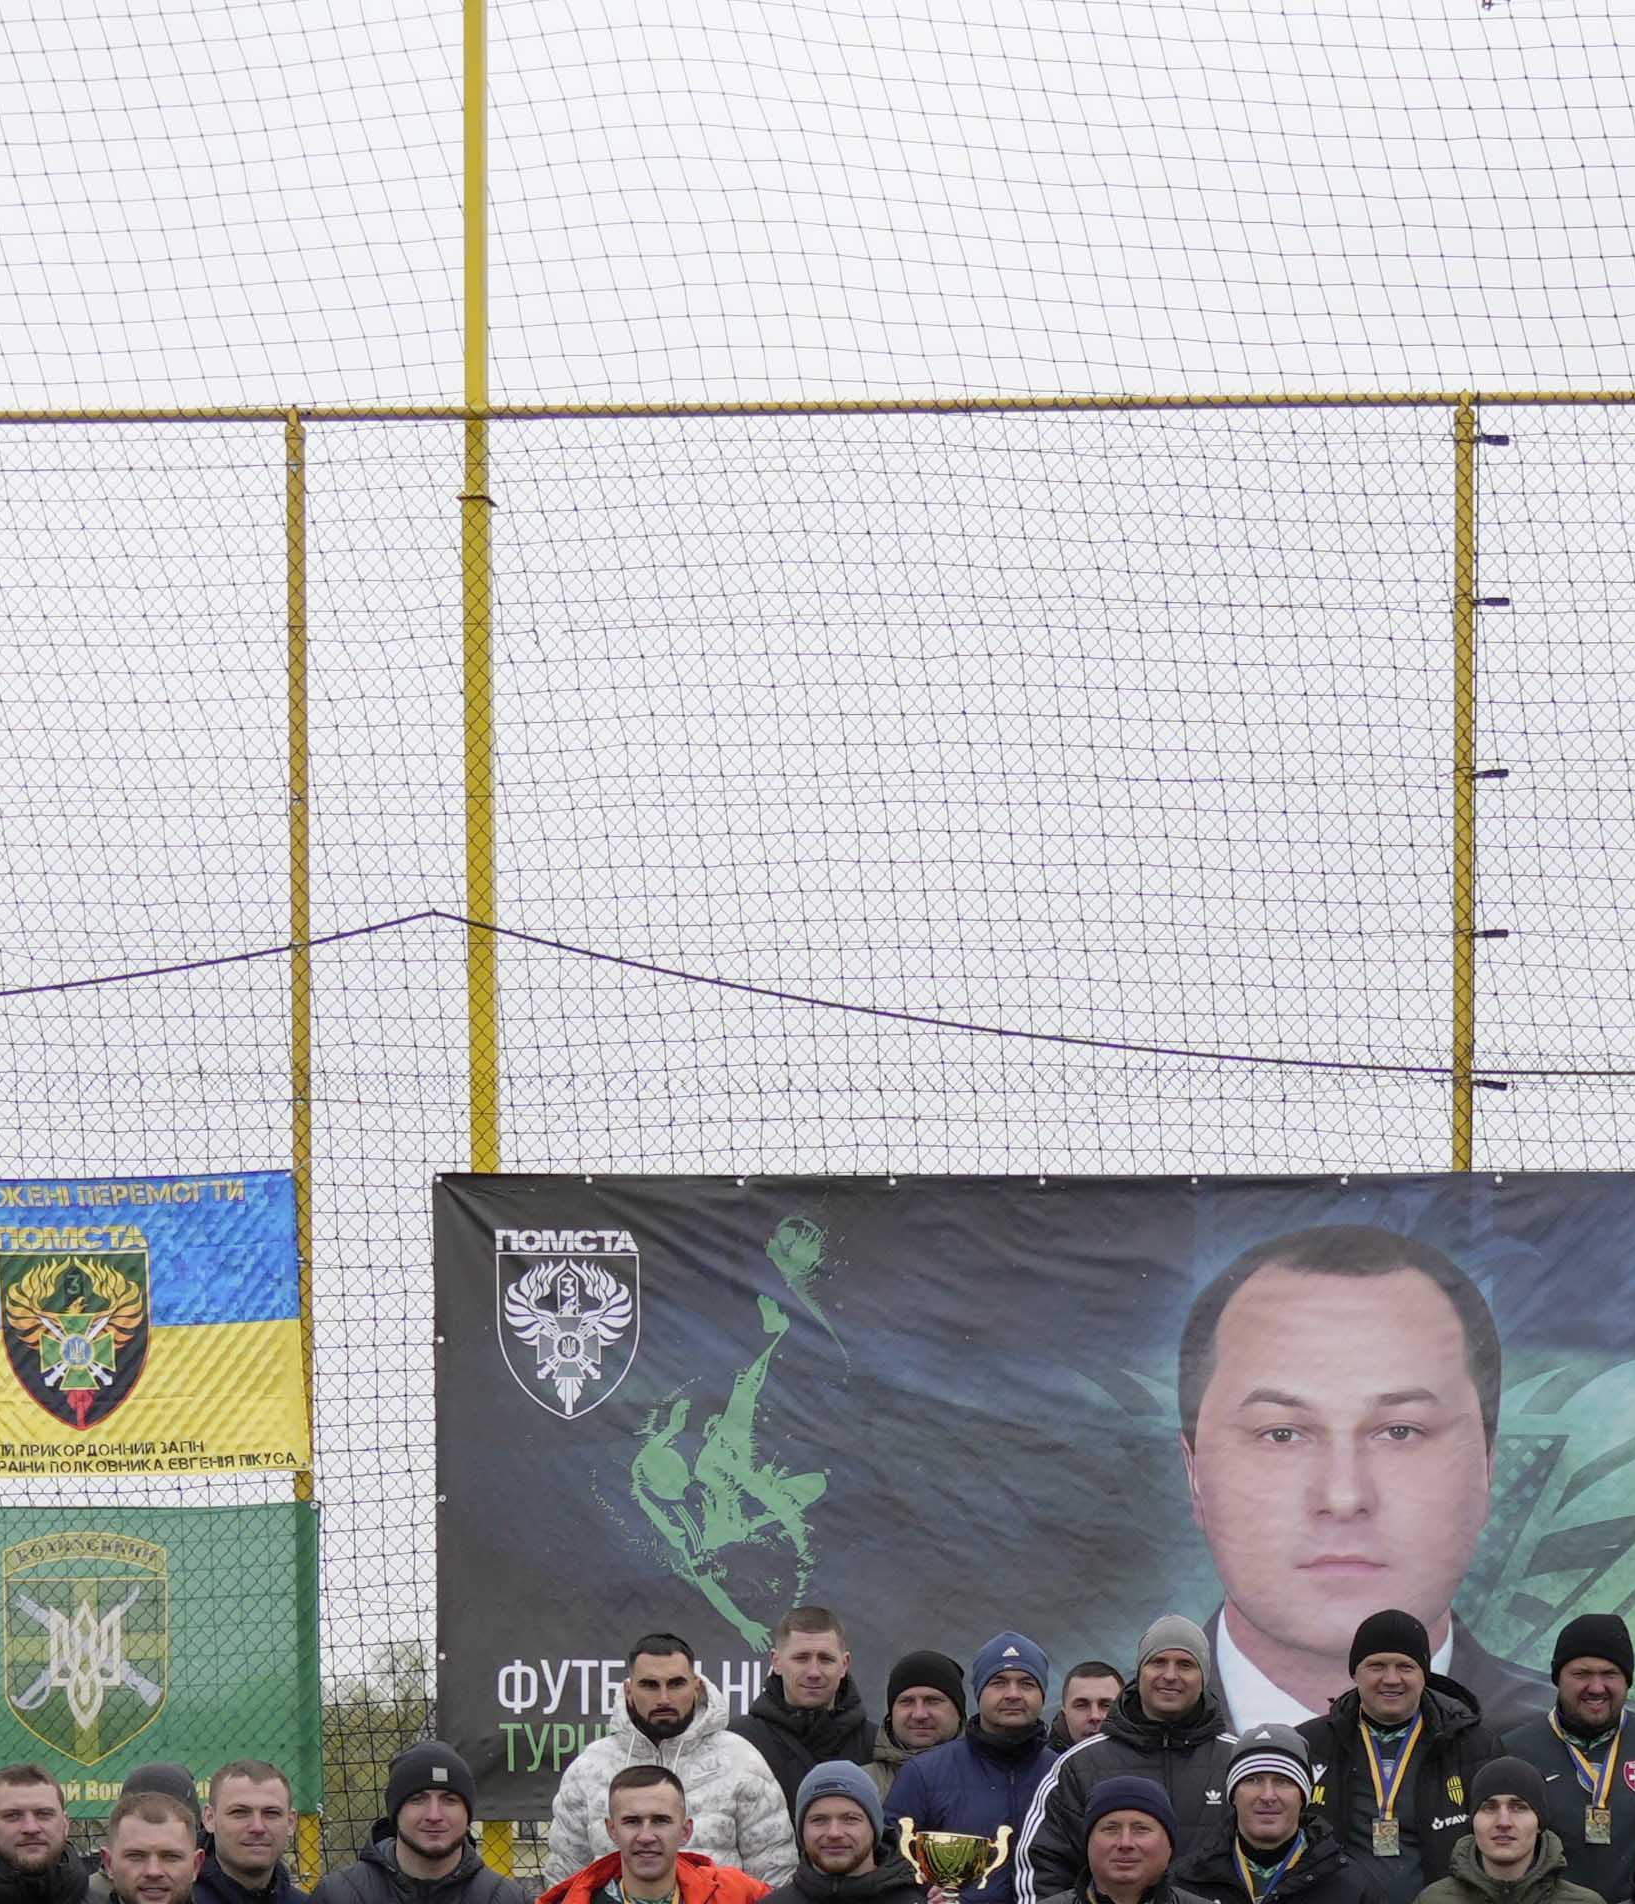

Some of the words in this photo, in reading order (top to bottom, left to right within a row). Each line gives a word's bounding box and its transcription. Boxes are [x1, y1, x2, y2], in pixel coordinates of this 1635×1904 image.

[494, 1228, 640, 1253] ПОМСТА
[560, 1277, 576, 1297] 3
[19, 1442, 156, 1458] ПРИКОРДОННИЙ
[160, 1441, 204, 1454] ЗАГІН
[49, 1458, 164, 1473] ПОЛКОВНИКА
[167, 1456, 234, 1470] ЄВГЕНІЯ
[237, 1453, 298, 1467] ПІКУСА
